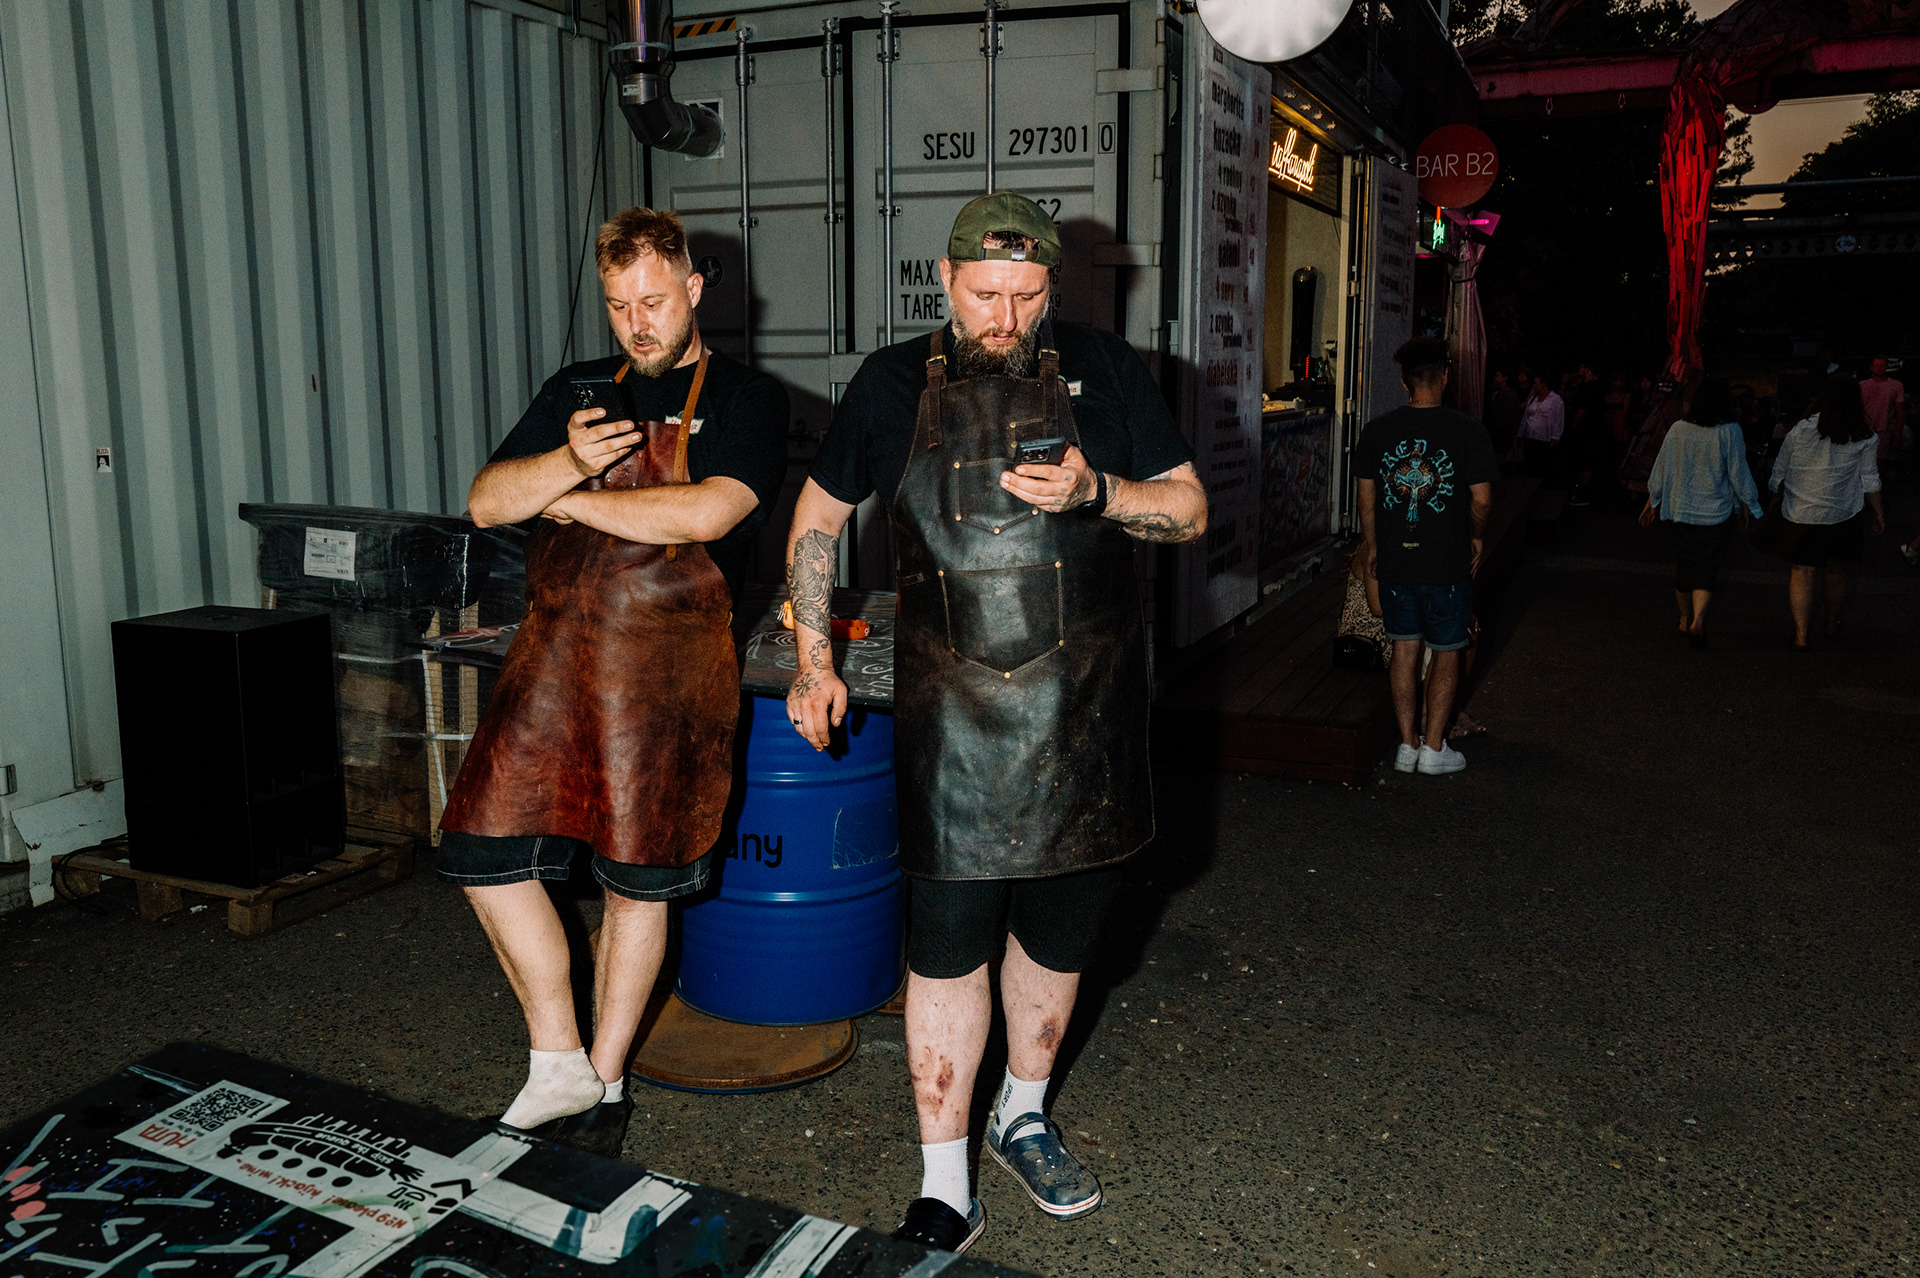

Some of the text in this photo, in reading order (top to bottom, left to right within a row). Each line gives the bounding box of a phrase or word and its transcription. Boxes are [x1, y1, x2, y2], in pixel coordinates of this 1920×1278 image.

[1212, 81, 1244, 121] margherita
[923, 131, 974, 160] SESU
[1008, 123, 1113, 155] 297301 0
[1416, 151, 1495, 179] BAR B2
[1219, 238, 1240, 268] salami
[900, 259, 938, 286] MAX.
[900, 293, 943, 319] TARE
[139, 1124, 195, 1148] HUTA
[314, 1132, 395, 1164] skip the queue
[278, 1177, 321, 1197] hijack!
